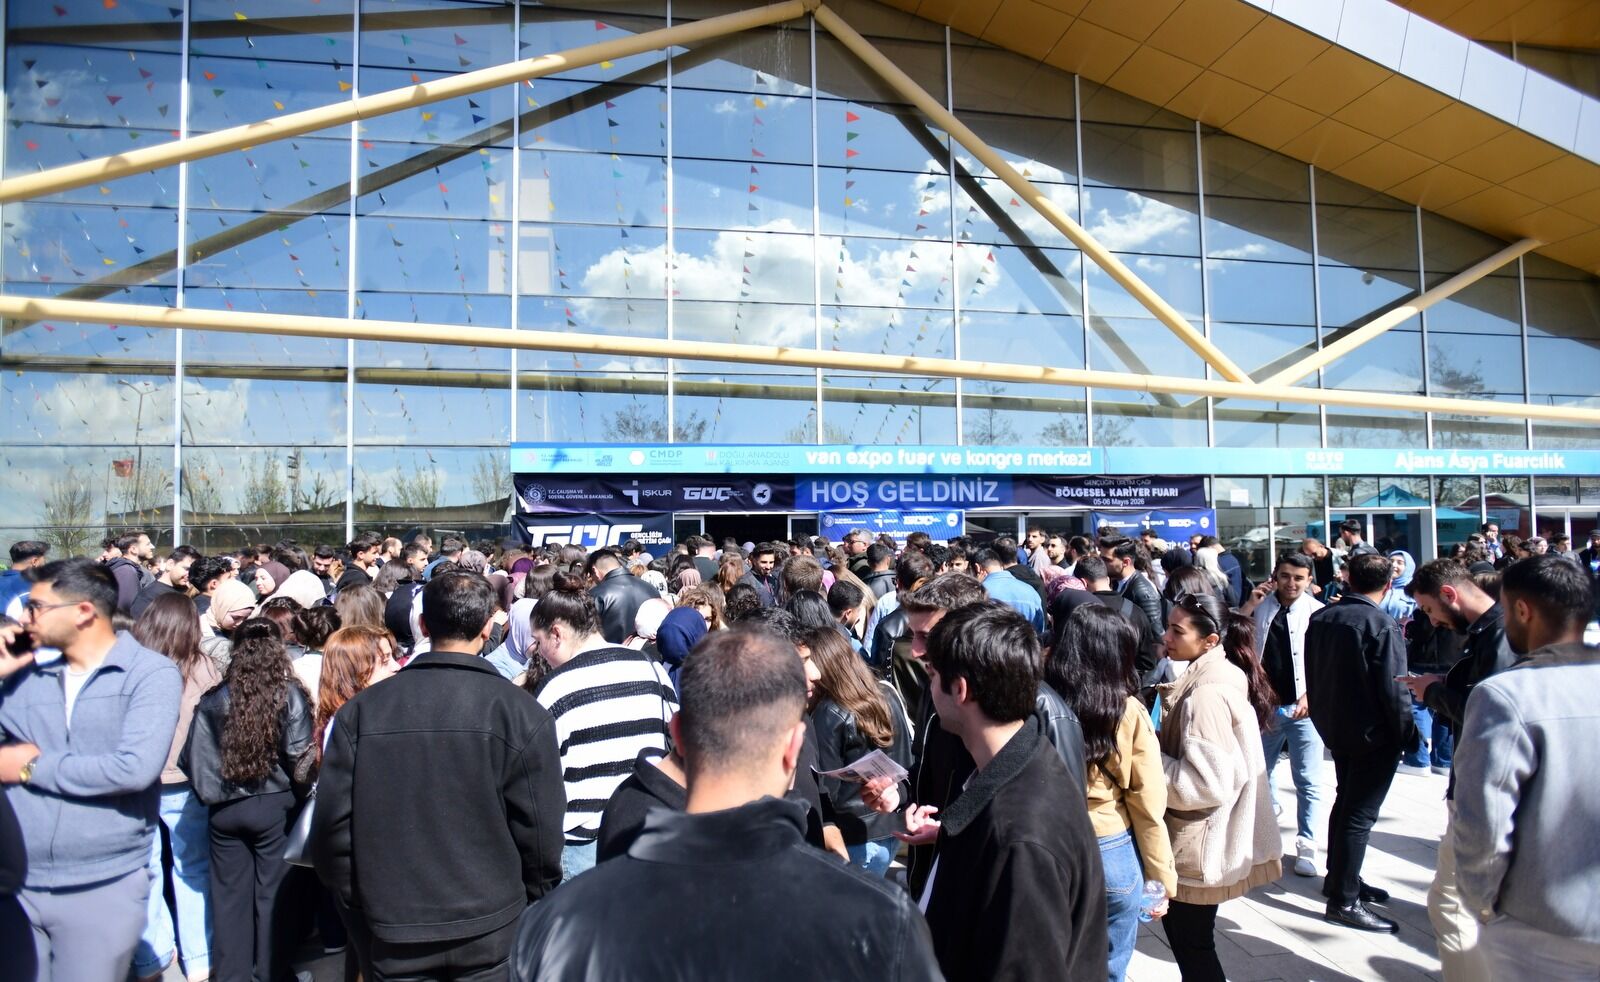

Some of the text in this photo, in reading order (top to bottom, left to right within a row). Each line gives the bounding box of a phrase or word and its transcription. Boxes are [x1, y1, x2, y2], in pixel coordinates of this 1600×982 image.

[649, 450, 683, 459] CMDP
[747, 451, 790, 459] ANADOLU
[806, 449, 1091, 469] van expo fuar ve kongre merkezi
[1395, 451, 1444, 472] Ajans
[1493, 452, 1565, 469] Fuarcılık
[812, 476, 999, 508] HOŞ GELDİNİZ
[1055, 486, 1179, 498] BÖLGESEL KARİYER FUARI
[1111, 498, 1129, 507] Mayıs
